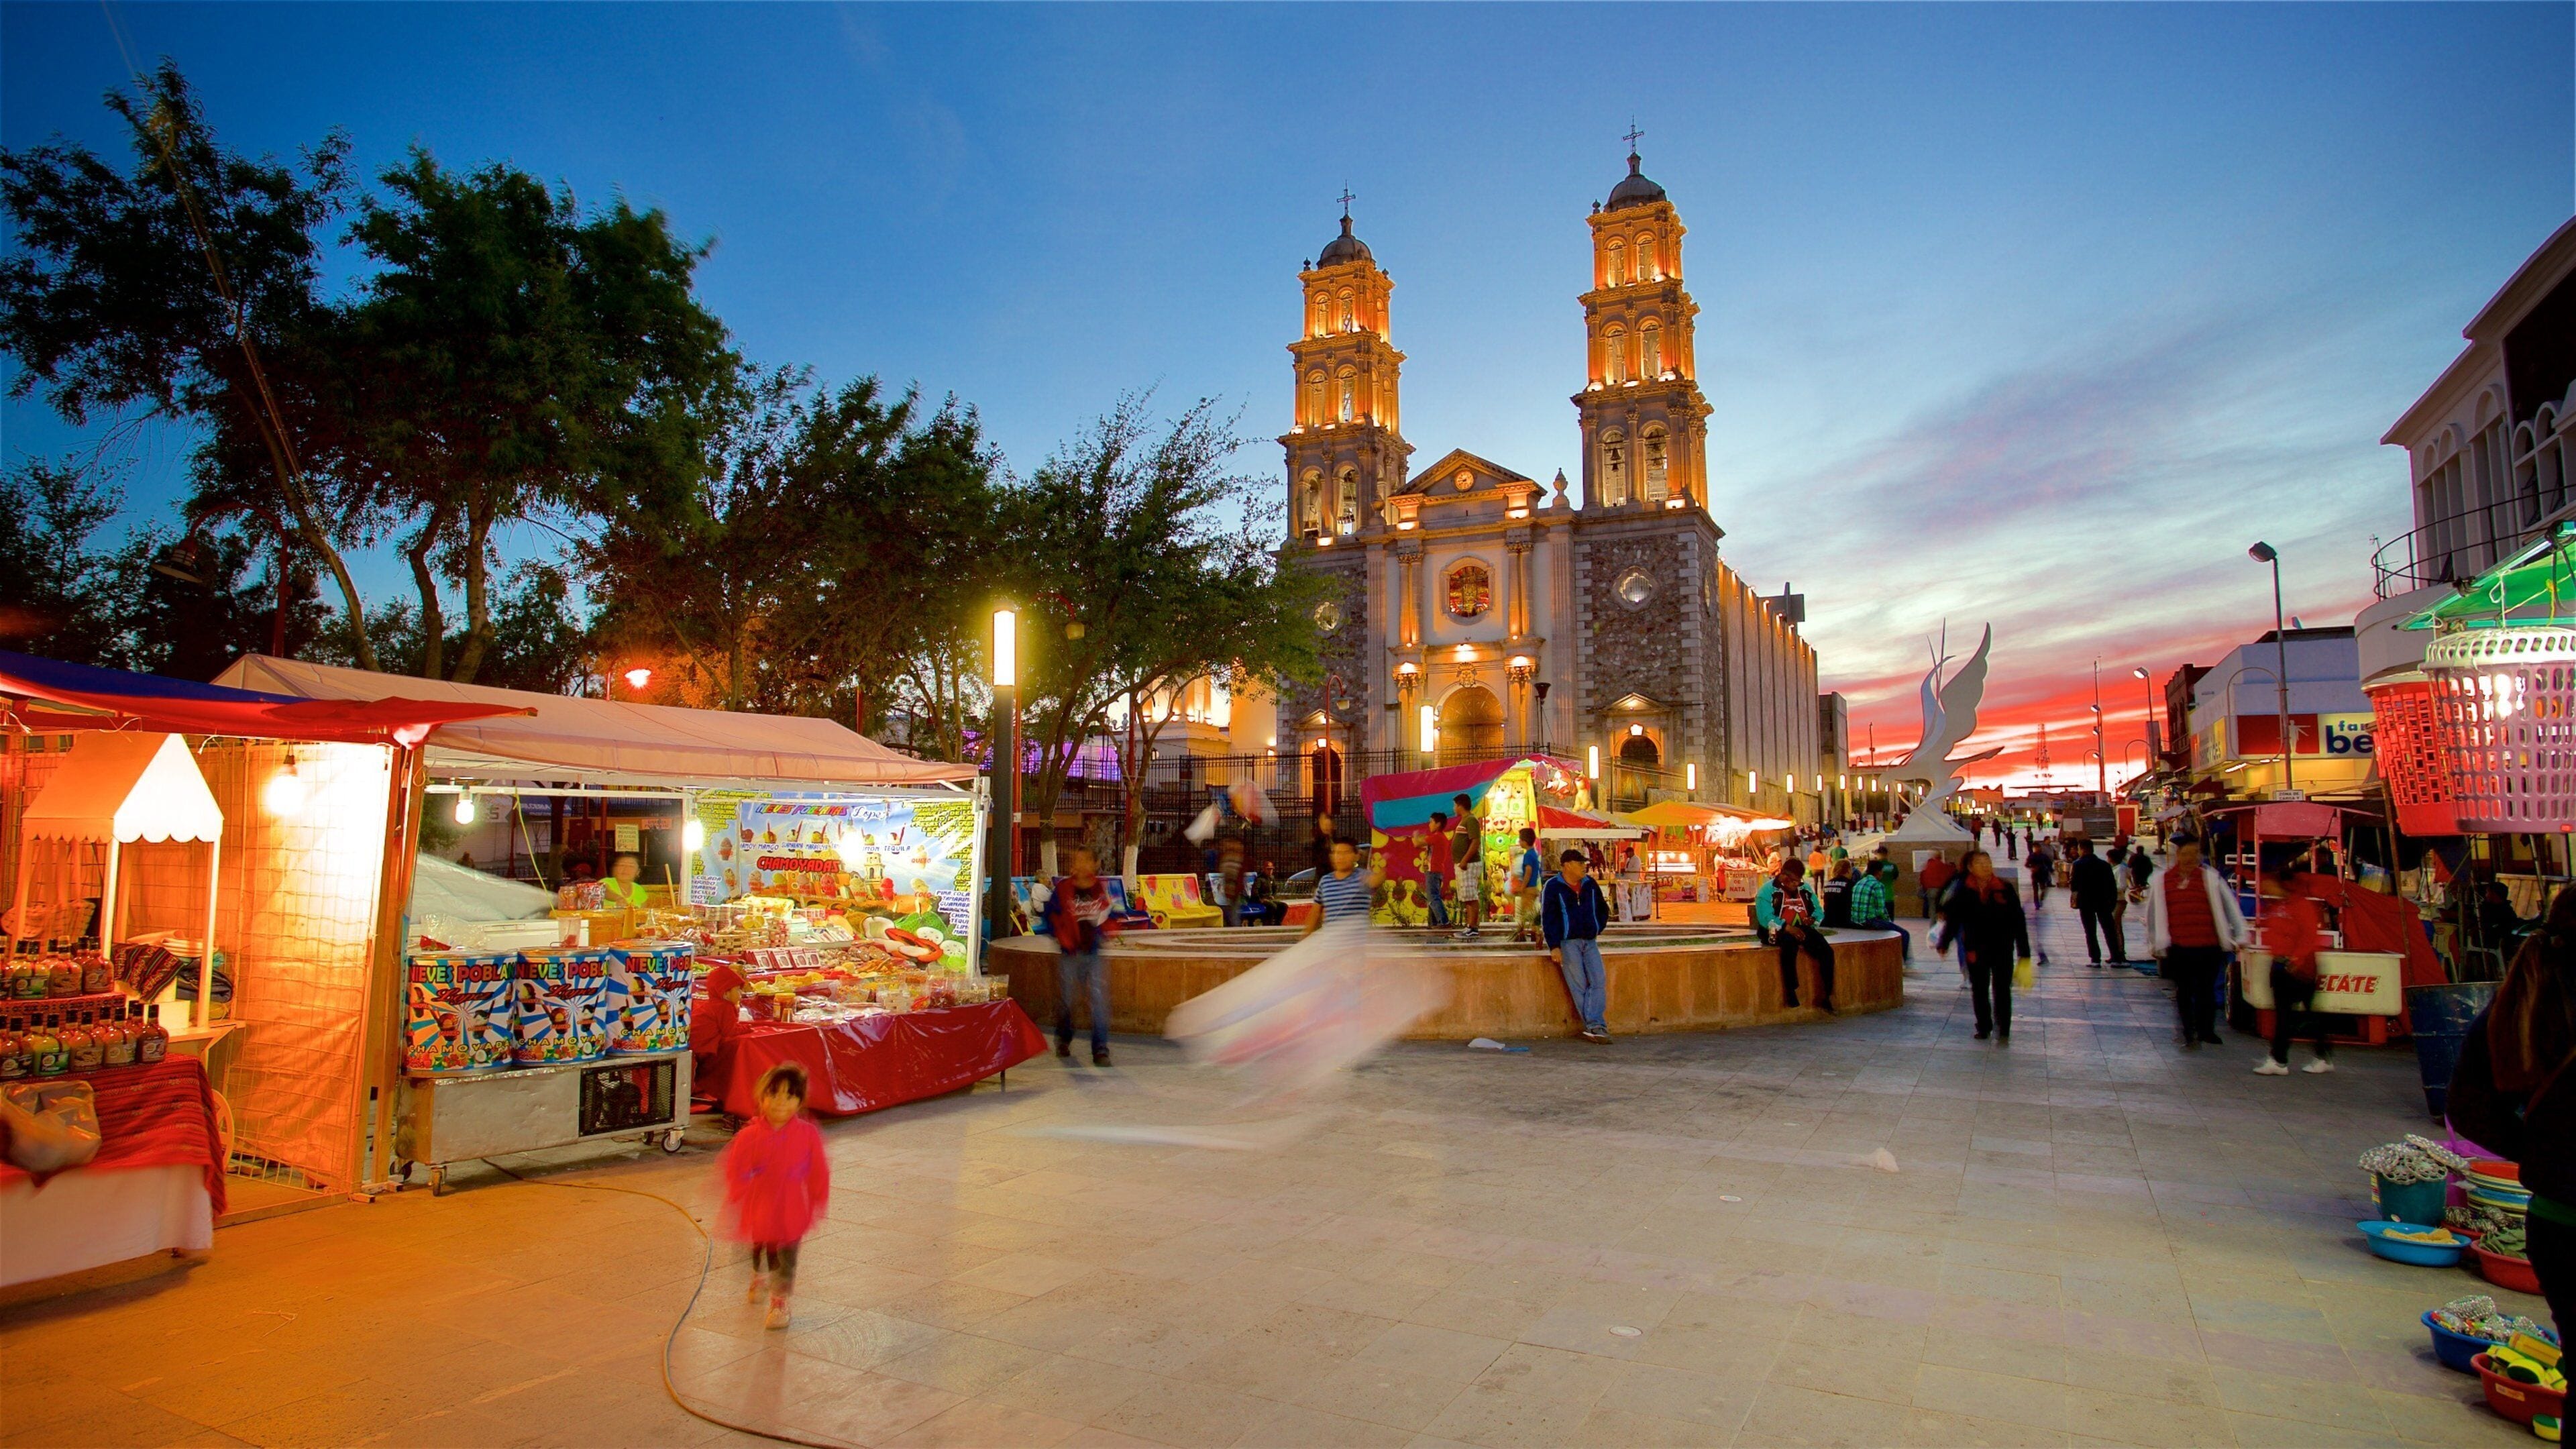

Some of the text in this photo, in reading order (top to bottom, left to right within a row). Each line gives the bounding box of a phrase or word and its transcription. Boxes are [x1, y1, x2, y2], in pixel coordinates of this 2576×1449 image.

[755, 803, 796, 815] NIEVES
[792, 804, 849, 816] POBLANAS
[756, 855, 842, 873] CHAMOYADAS
[515, 962, 565, 980] NIEVES
[625, 956, 668, 973] NIEVES
[409, 965, 454, 983] NIEVES
